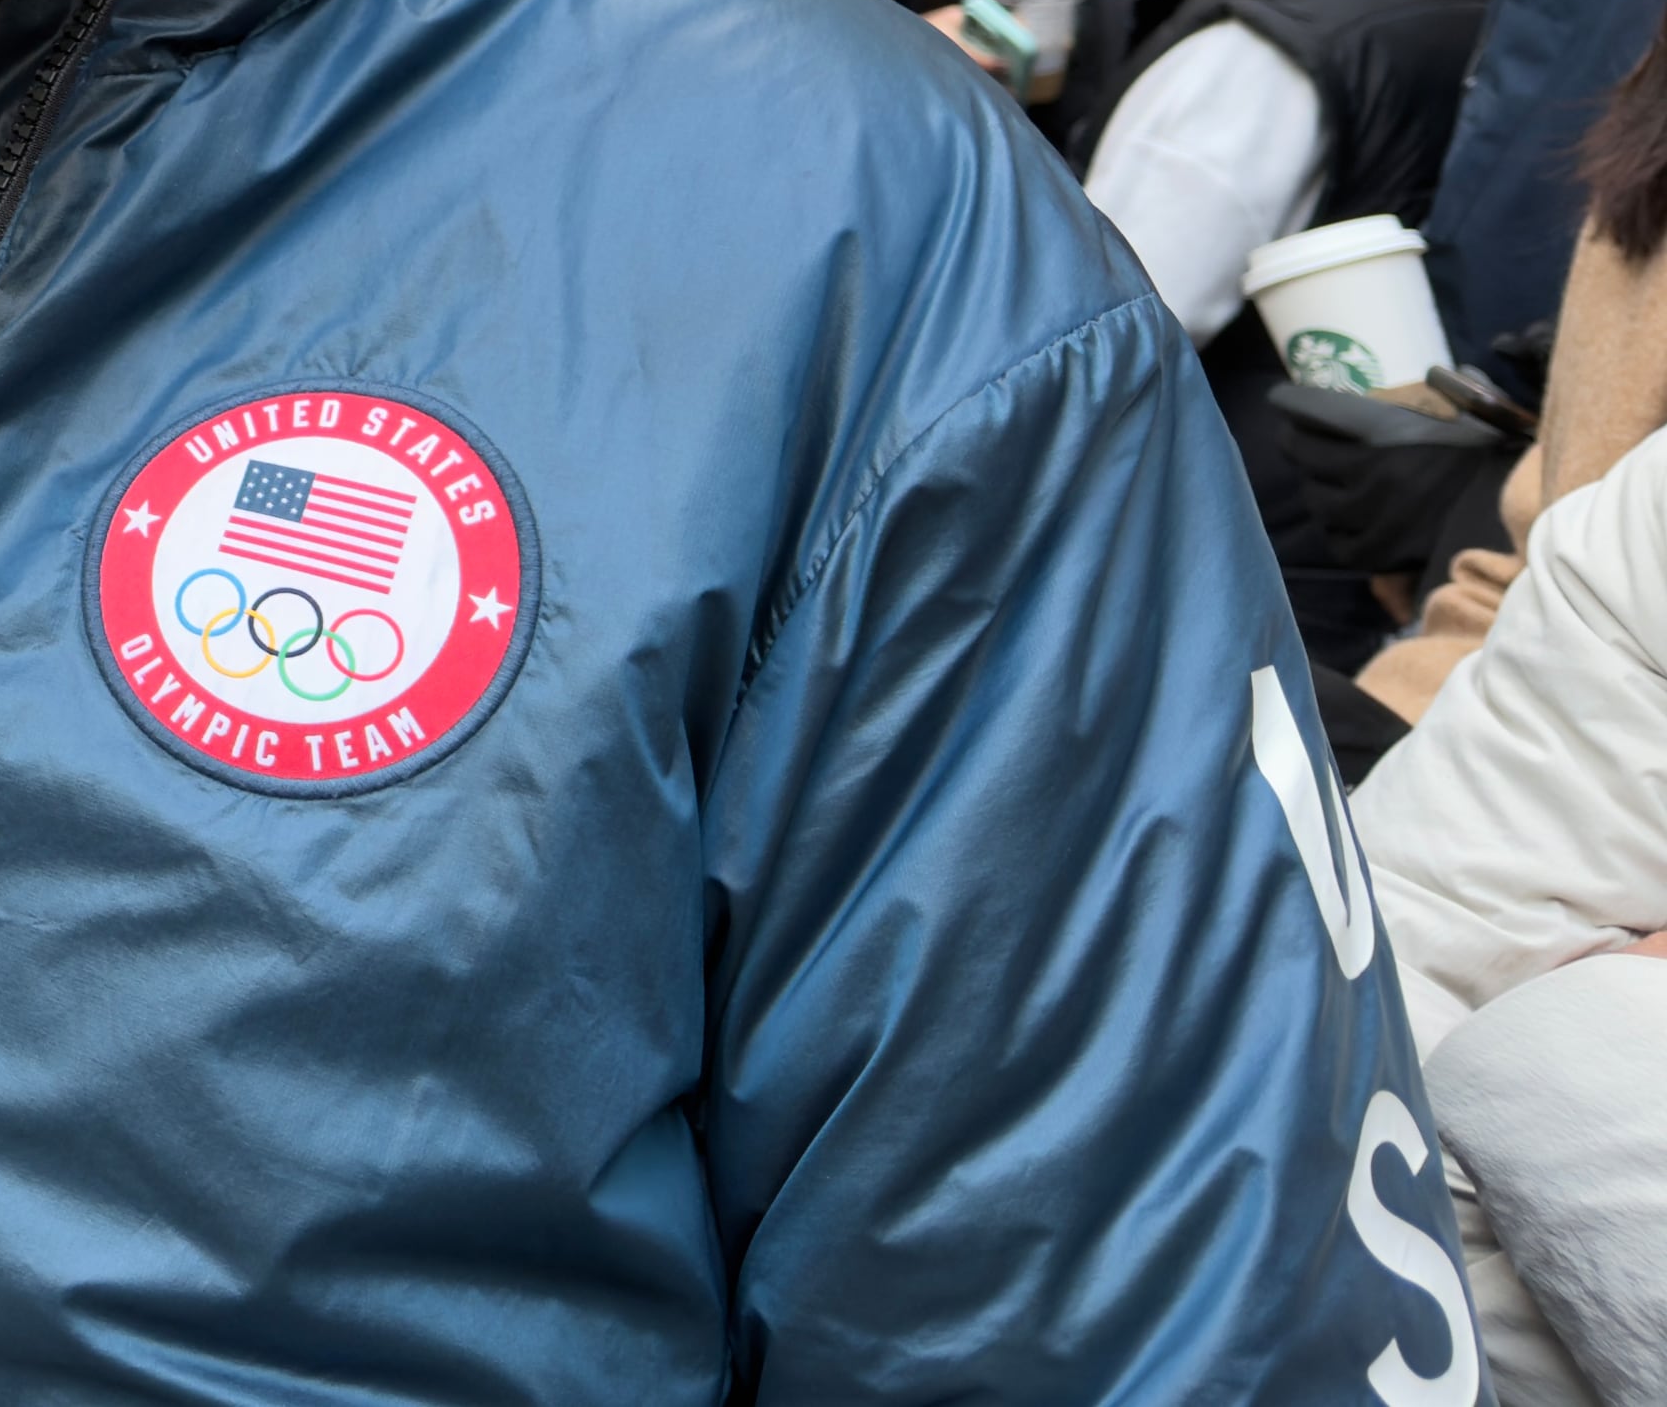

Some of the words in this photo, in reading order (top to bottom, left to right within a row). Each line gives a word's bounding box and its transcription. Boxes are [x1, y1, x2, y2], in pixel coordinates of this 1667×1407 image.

[185, 399, 341, 464] UNITED
[361, 407, 496, 526] STATES
[121, 633, 279, 768] OLYMPIC
[305, 706, 427, 772] TEAM
